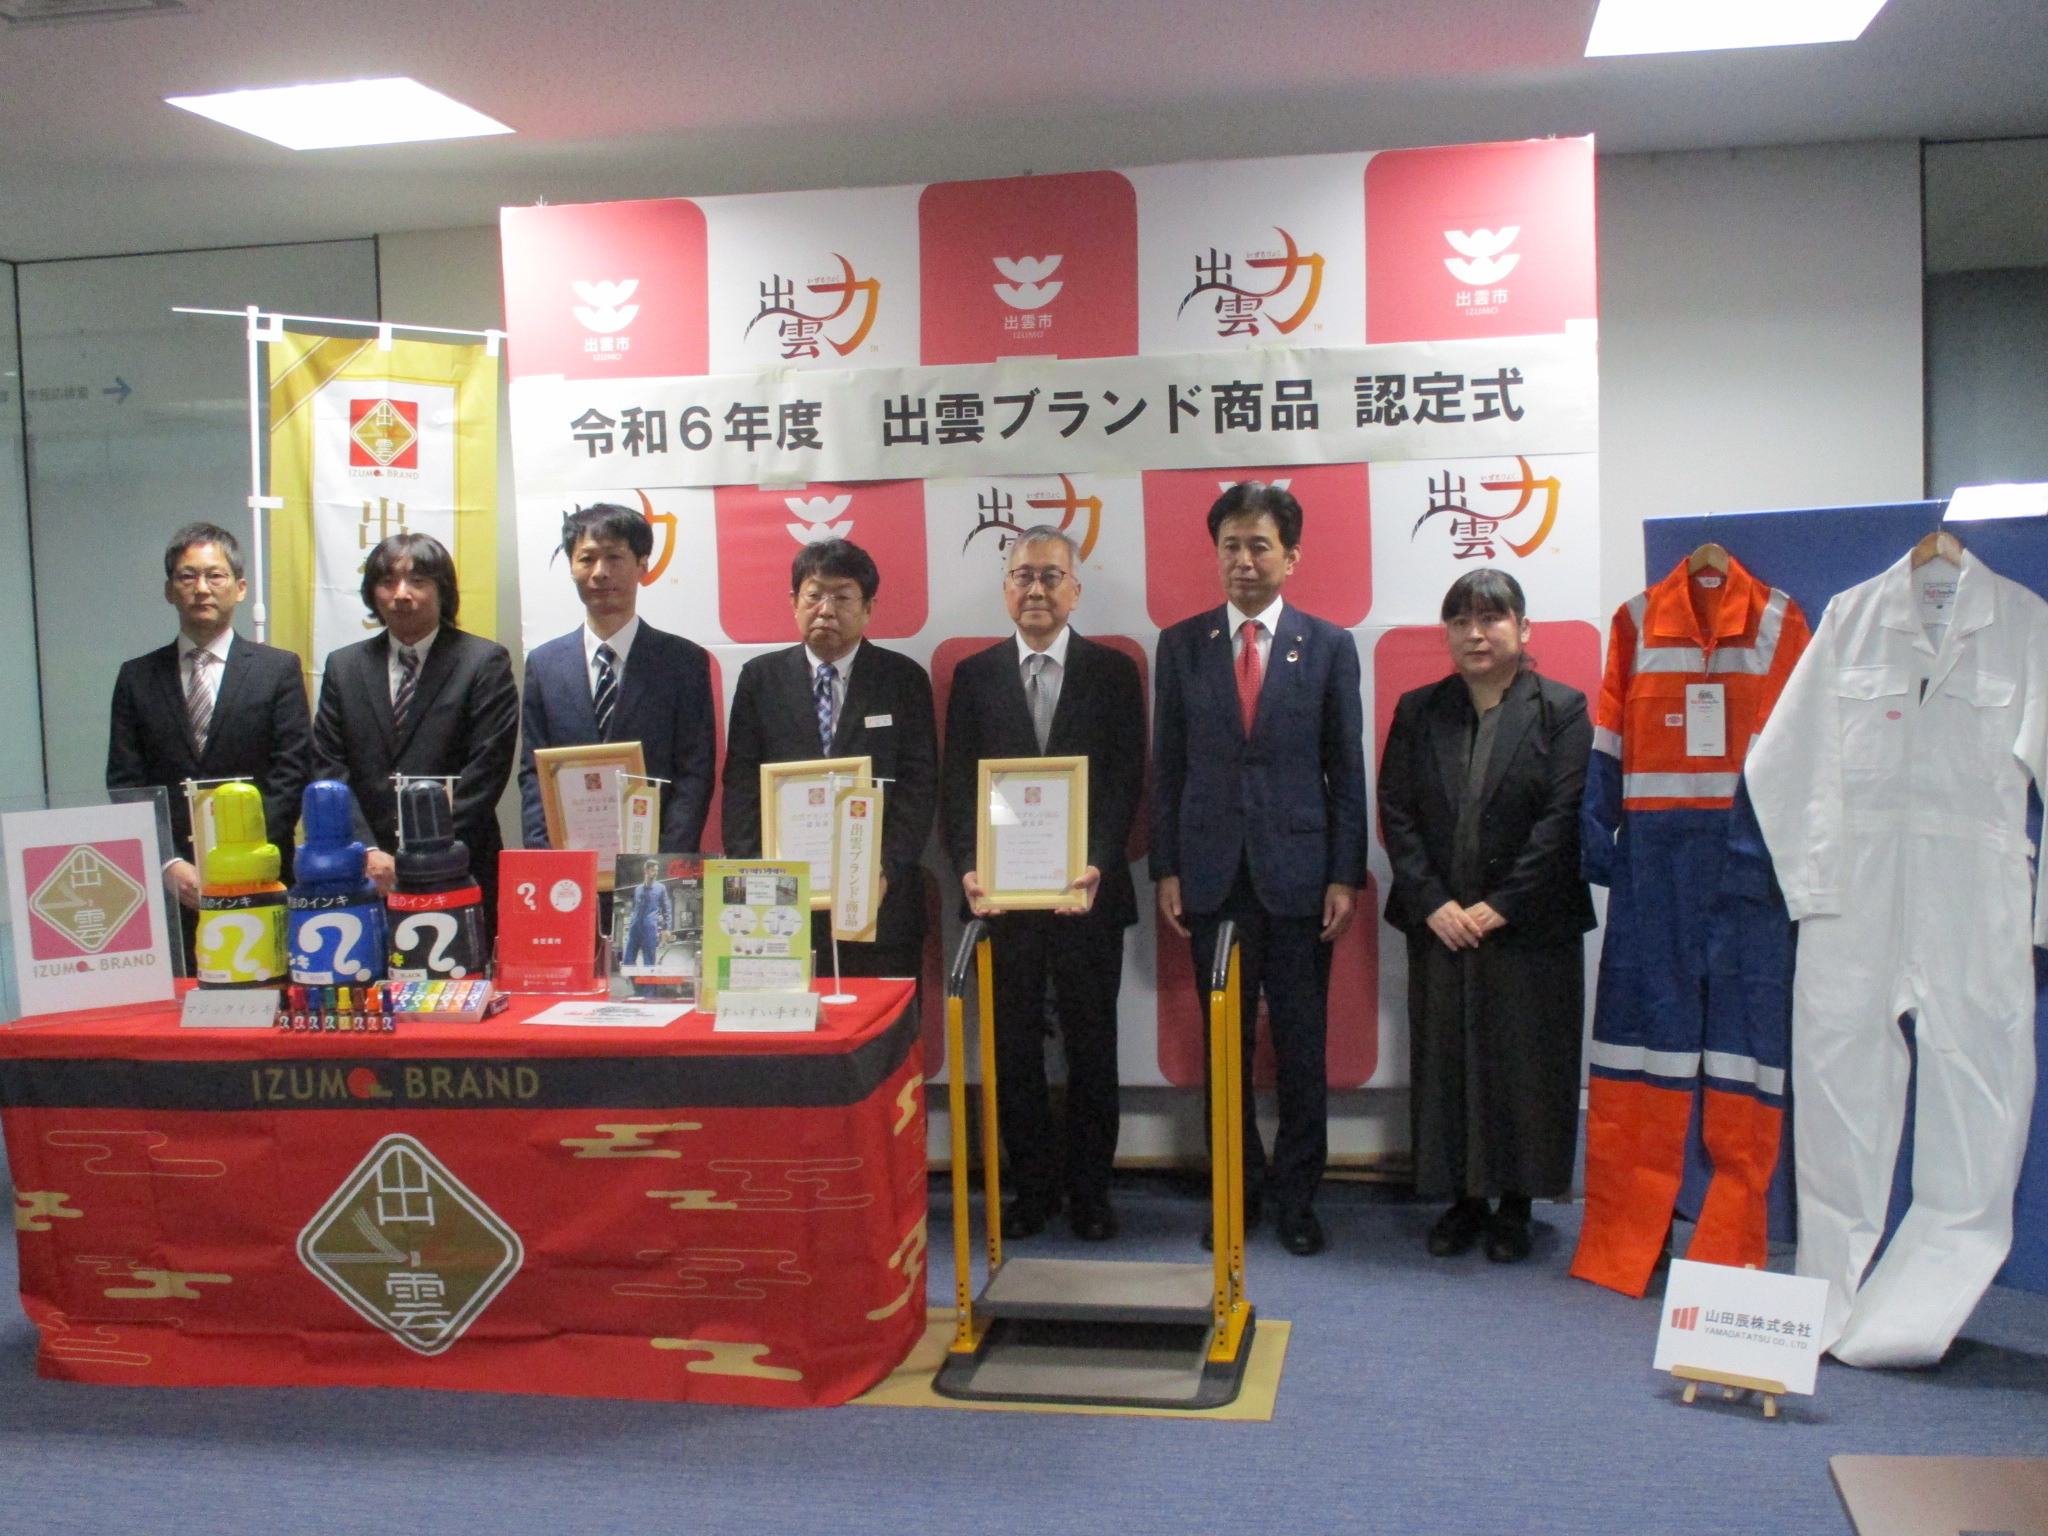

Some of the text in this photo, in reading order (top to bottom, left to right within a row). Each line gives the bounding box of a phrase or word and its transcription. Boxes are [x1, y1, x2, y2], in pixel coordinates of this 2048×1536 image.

[1455, 288, 1509, 307] 出雲市
[1465, 307, 1499, 316] IZUMO
[1004, 313, 1053, 330] 出雲市
[1013, 331, 1044, 339] IZUMO
[584, 336, 630, 352] 出雲市
[593, 353, 622, 361] IZUMO
[570, 367, 1525, 458] 令和6年度 出雲ブランド商品 認定式
[387, 470, 419, 480] BRAND
[100, 954, 156, 971] BRAND
[721, 1006, 812, 1020] すいすい手すり
[405, 1066, 539, 1099] BRAND
[375, 1148, 451, 1330] 出雲
[1705, 1309, 1812, 1337] 山田辰株式会社
[1704, 1328, 1770, 1344] YAMADATATSU
